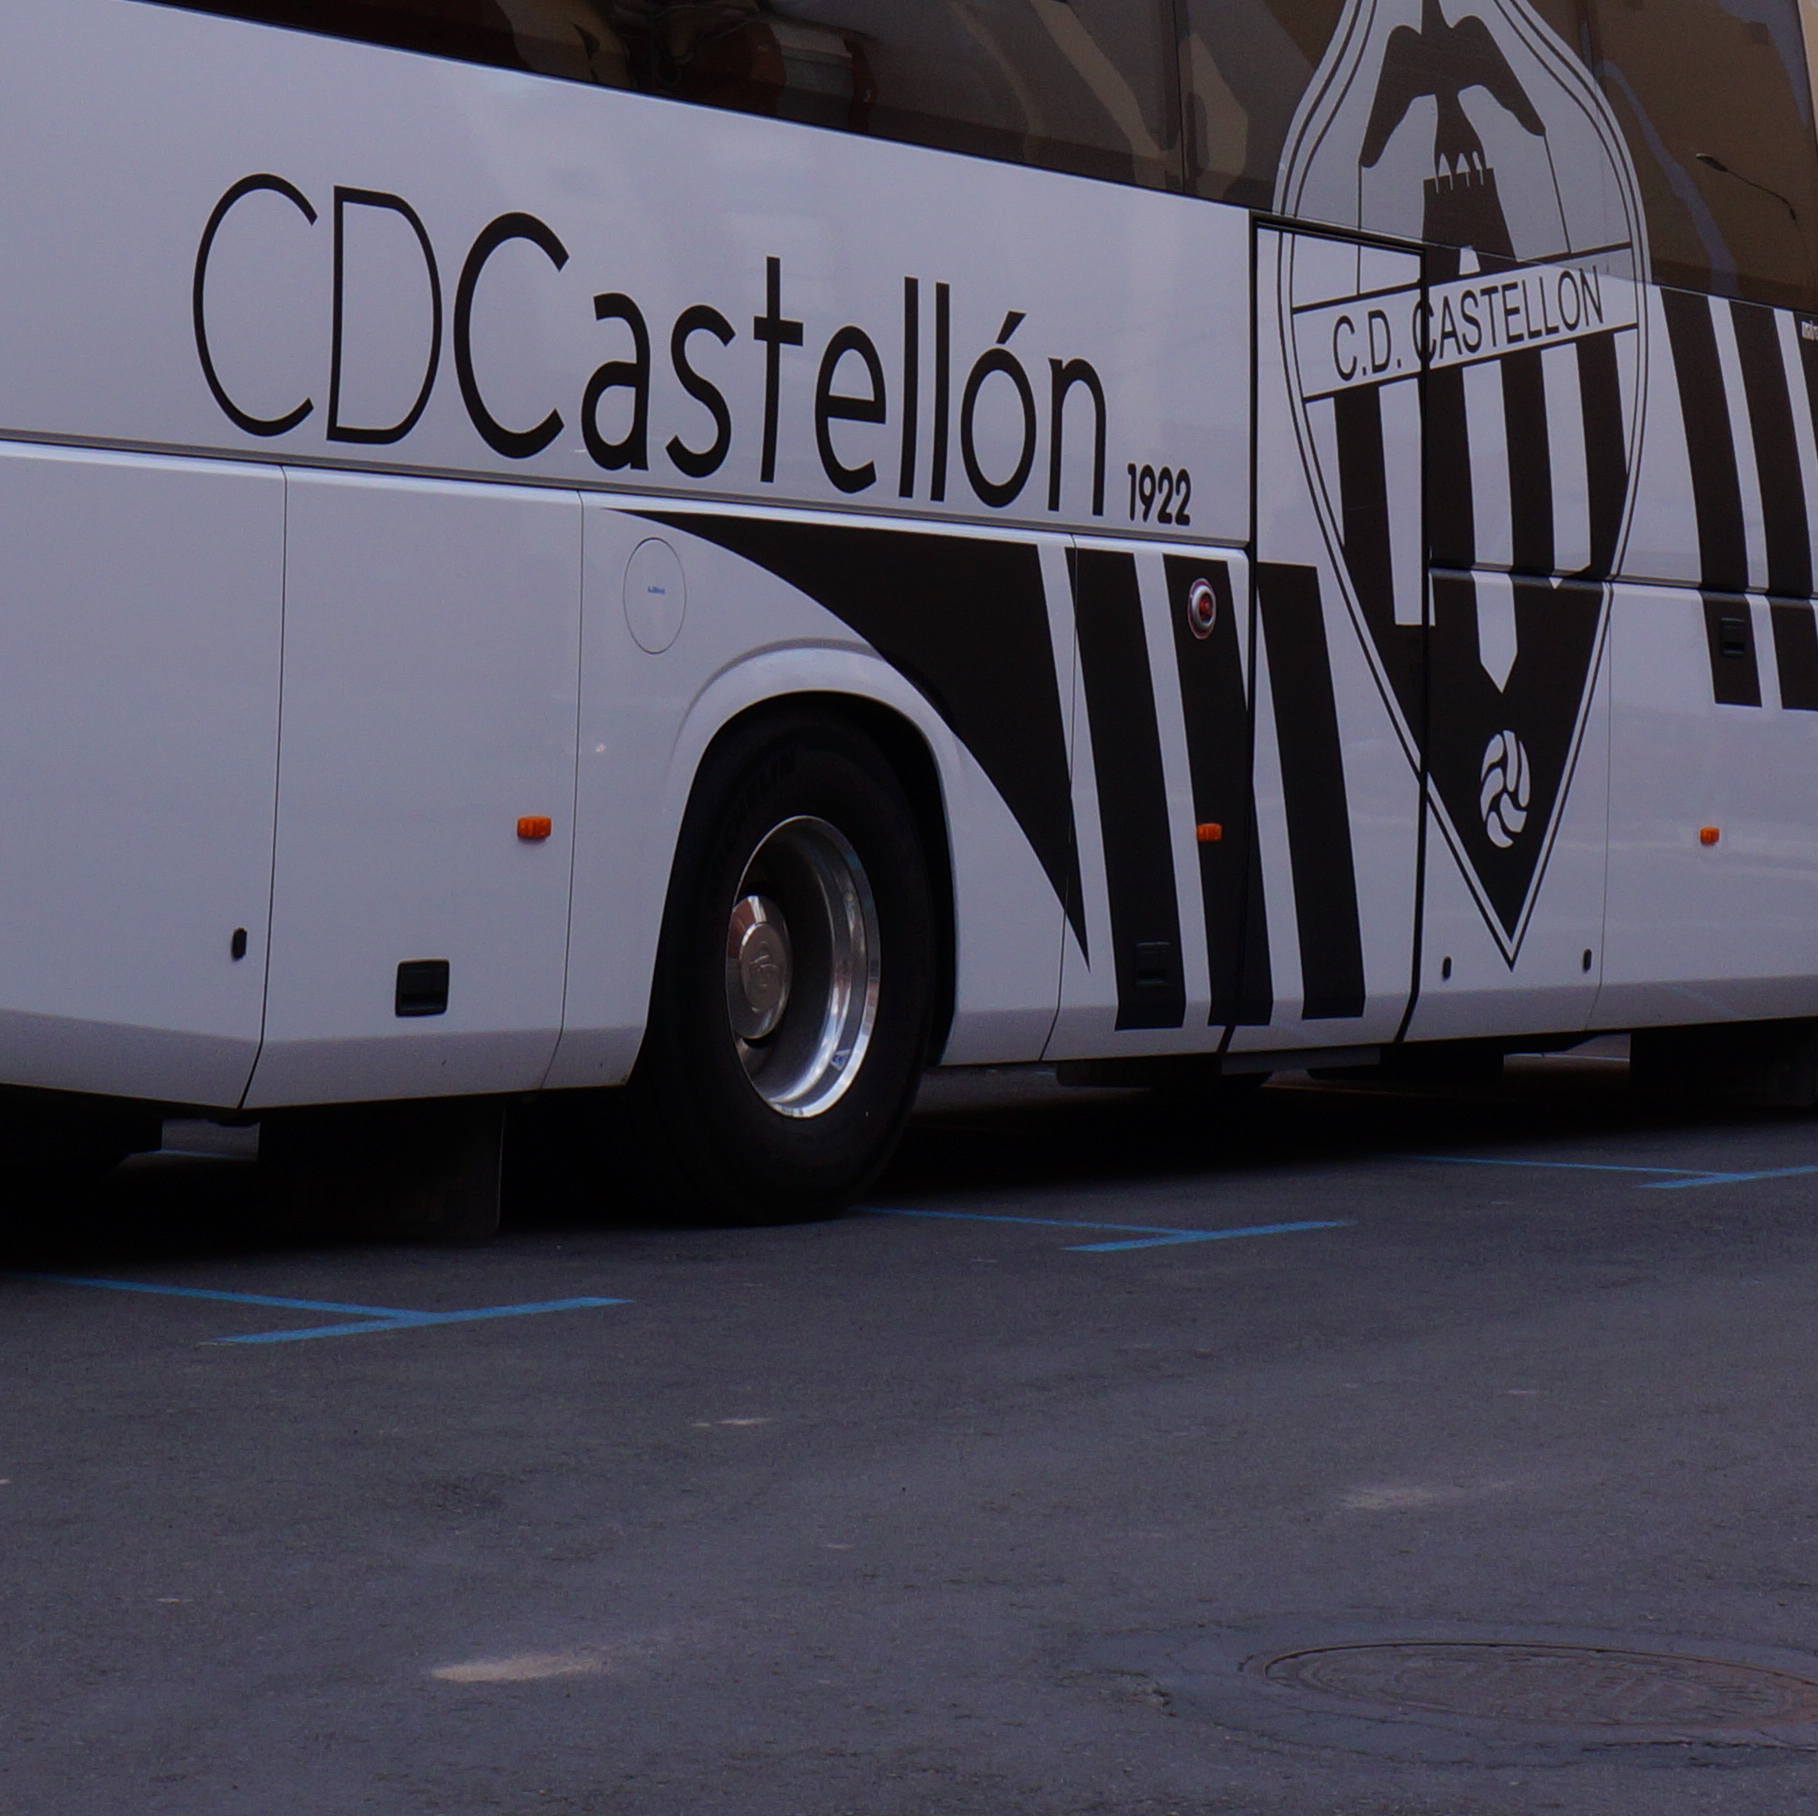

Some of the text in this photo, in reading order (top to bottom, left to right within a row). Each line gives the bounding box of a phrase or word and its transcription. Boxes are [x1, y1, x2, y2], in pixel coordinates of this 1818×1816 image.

[1332, 264, 1605, 382] C.D. CASTELLON
[1126, 462, 1192, 527] 1922
